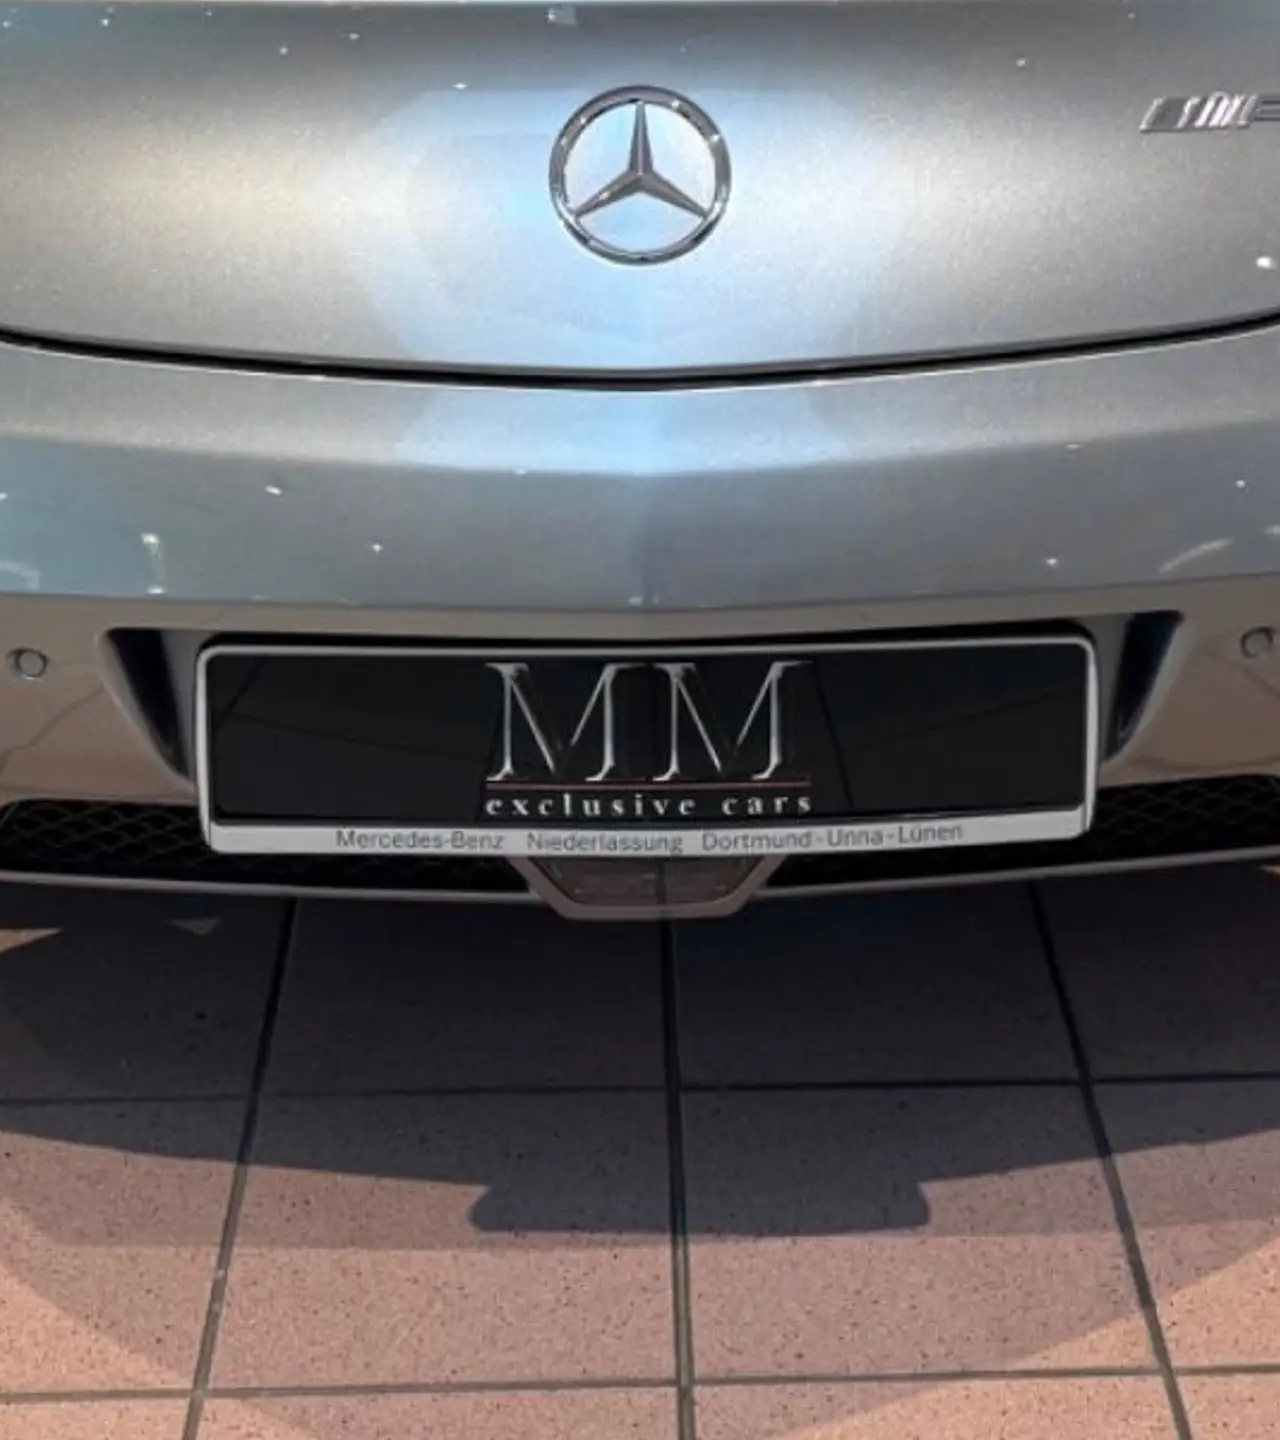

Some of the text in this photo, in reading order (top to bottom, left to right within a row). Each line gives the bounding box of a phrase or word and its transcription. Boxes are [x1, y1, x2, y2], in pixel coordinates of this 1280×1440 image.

[484, 660, 813, 782] MM
[484, 792, 813, 817] exclusive cars
[335, 827, 505, 850] Mercedes-Benz
[526, 830, 685, 855] Niederlassung
